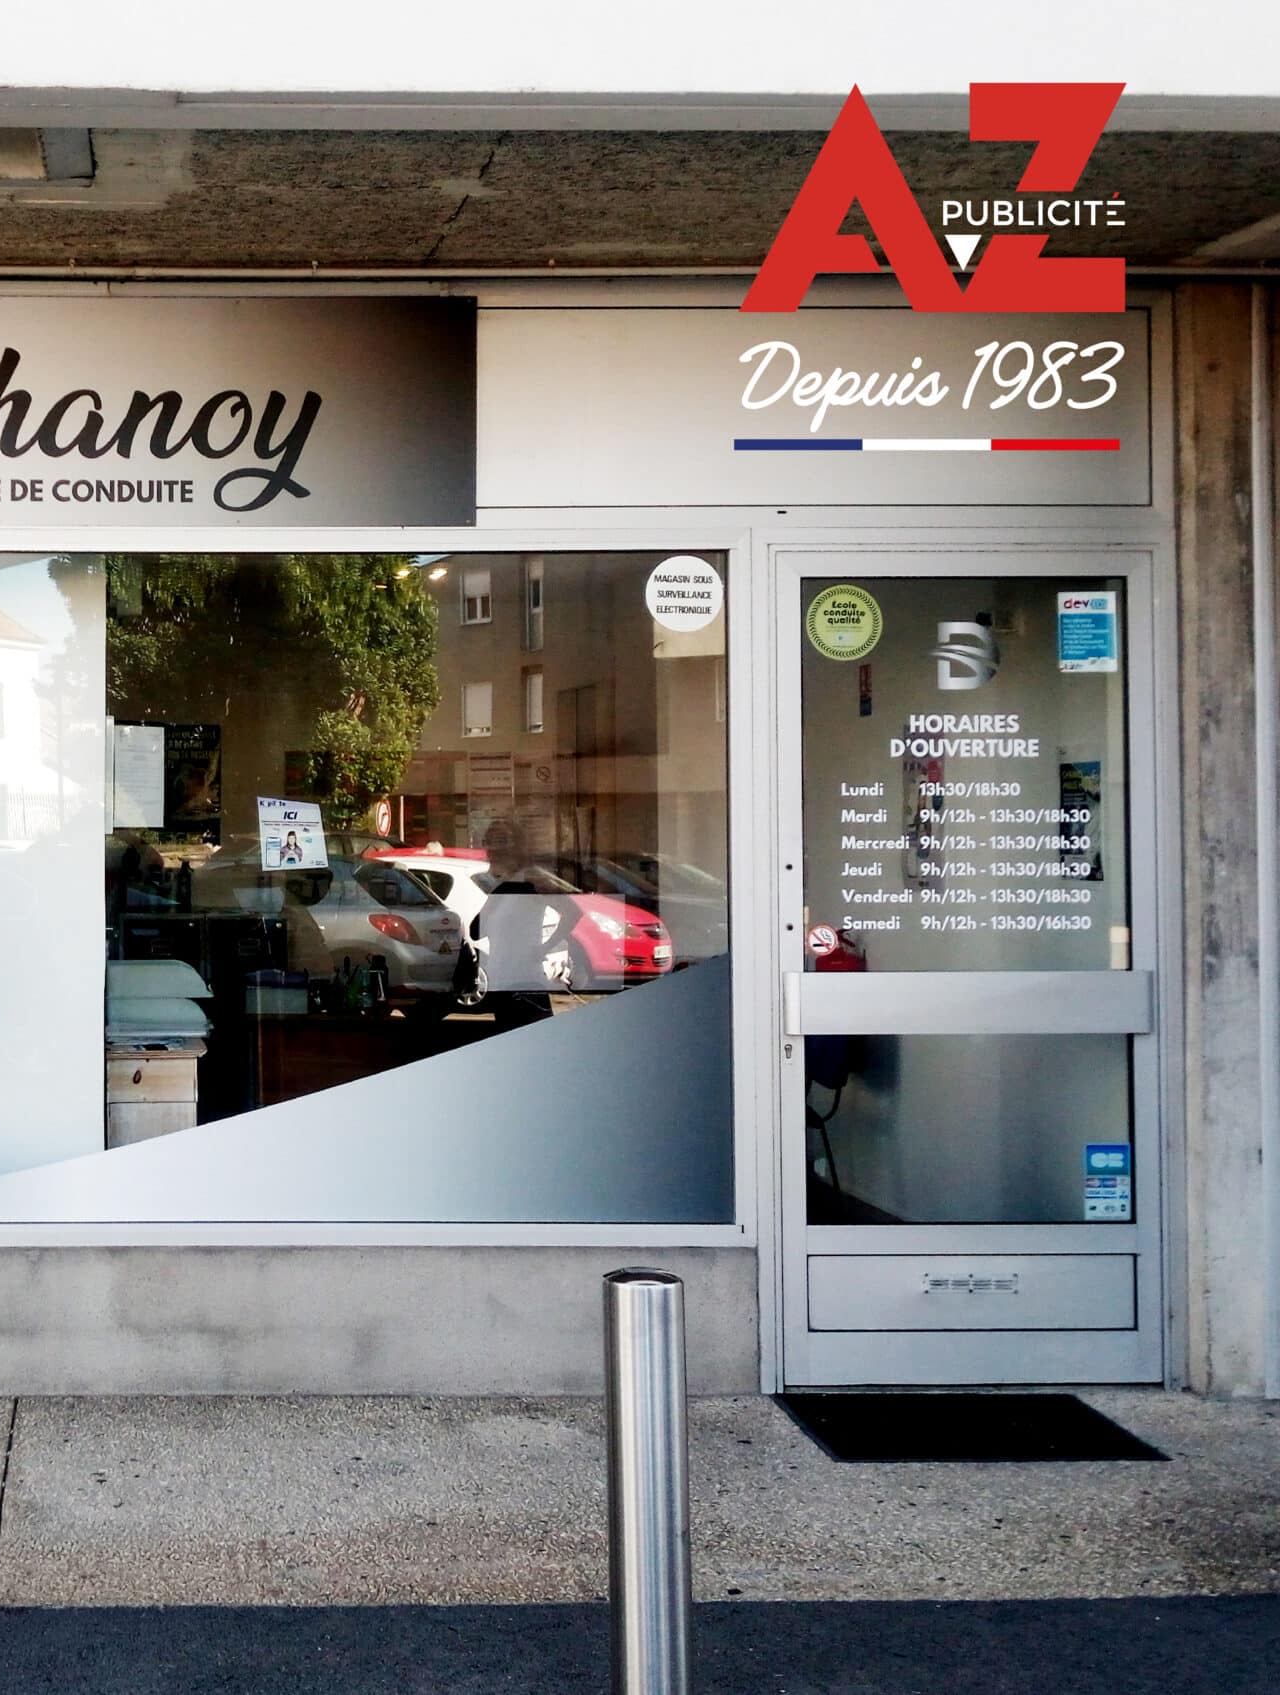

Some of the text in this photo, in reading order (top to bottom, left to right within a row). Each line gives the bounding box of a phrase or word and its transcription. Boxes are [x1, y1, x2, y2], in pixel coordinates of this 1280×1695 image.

[10, 480, 44, 502] DE
[51, 479, 193, 503] CONDUITE
[653, 575, 713, 584] MAGASIN SOUS
[657, 590, 712, 599] SURVEILLANCE
[823, 609, 865, 617] conduite
[909, 714, 1020, 734] HORAIRES
[889, 738, 1040, 758] D'OUVERTURE
[841, 782, 1021, 798] Lundi 13h30/18h30
[283, 811, 298, 820] ICI
[841, 809, 887, 823] Mardi
[920, 809, 976, 825] 9h/12h
[990, 809, 1091, 825] 13h30/18h30
[841, 836, 910, 850] Mercredi
[920, 836, 976, 852] 9h/12h
[990, 836, 1091, 852] 13h30/18h30
[841, 863, 882, 877] Jeudi
[920, 863, 976, 879] 9h/12h
[990, 863, 1091, 879] 13h30/18h30
[841, 889, 913, 903] Vendredi
[920, 889, 976, 905] 9h/12h
[990, 889, 1091, 905] 13h30/18h30
[841, 916, 900, 930] Samedi
[920, 916, 976, 932] 9h/12h
[990, 916, 1091, 932] 13h30/16h30
